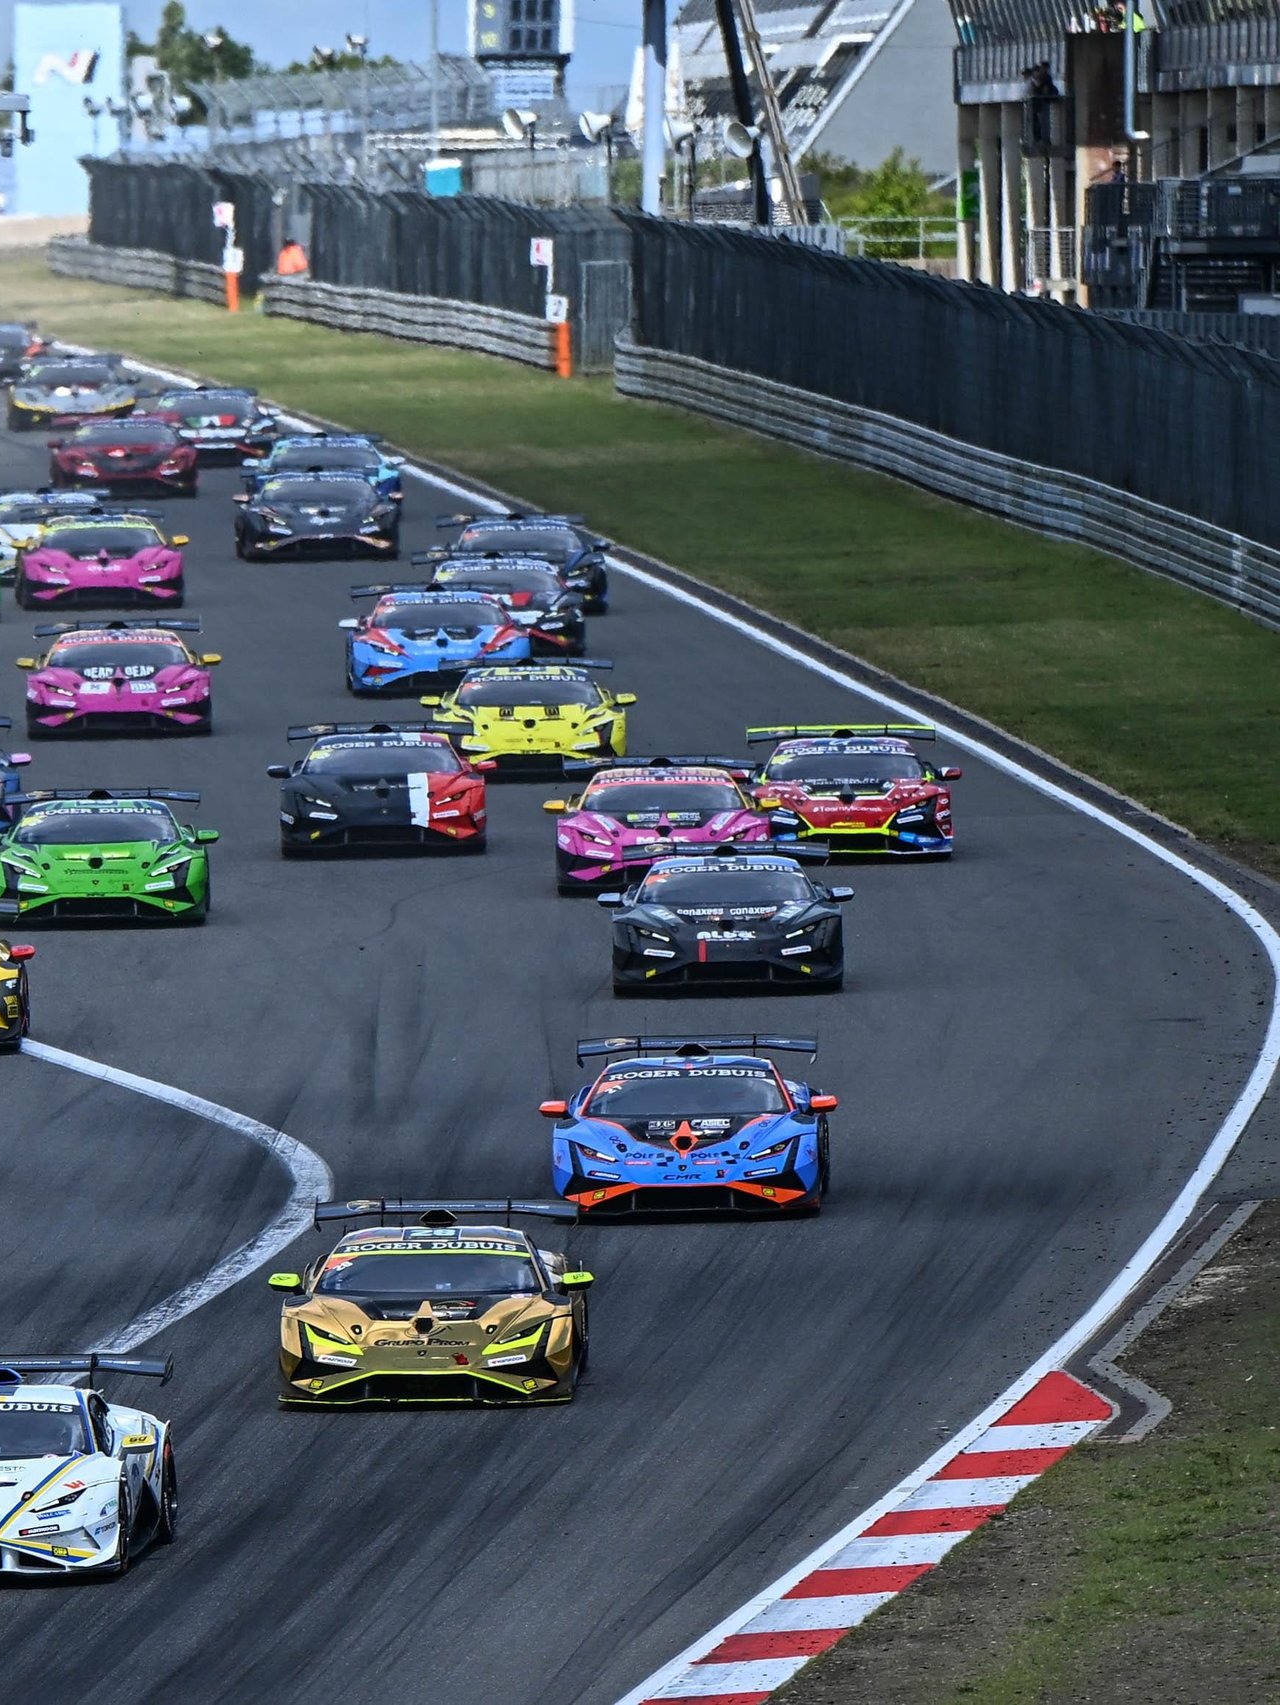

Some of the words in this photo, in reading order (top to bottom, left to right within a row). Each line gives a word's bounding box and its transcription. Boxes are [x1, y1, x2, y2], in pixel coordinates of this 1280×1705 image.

[472, 675, 522, 683] ROGER
[599, 777, 655, 785] ROGER
[659, 865, 720, 874] ROGER
[727, 864, 794, 872] DUBUIS
[609, 1070, 680, 1081] ROGER
[688, 1069, 766, 1078] DUBUIS
[663, 1173, 702, 1181] CMR
[344, 1242, 421, 1252] ROGER
[431, 1241, 517, 1251] DUBUIS
